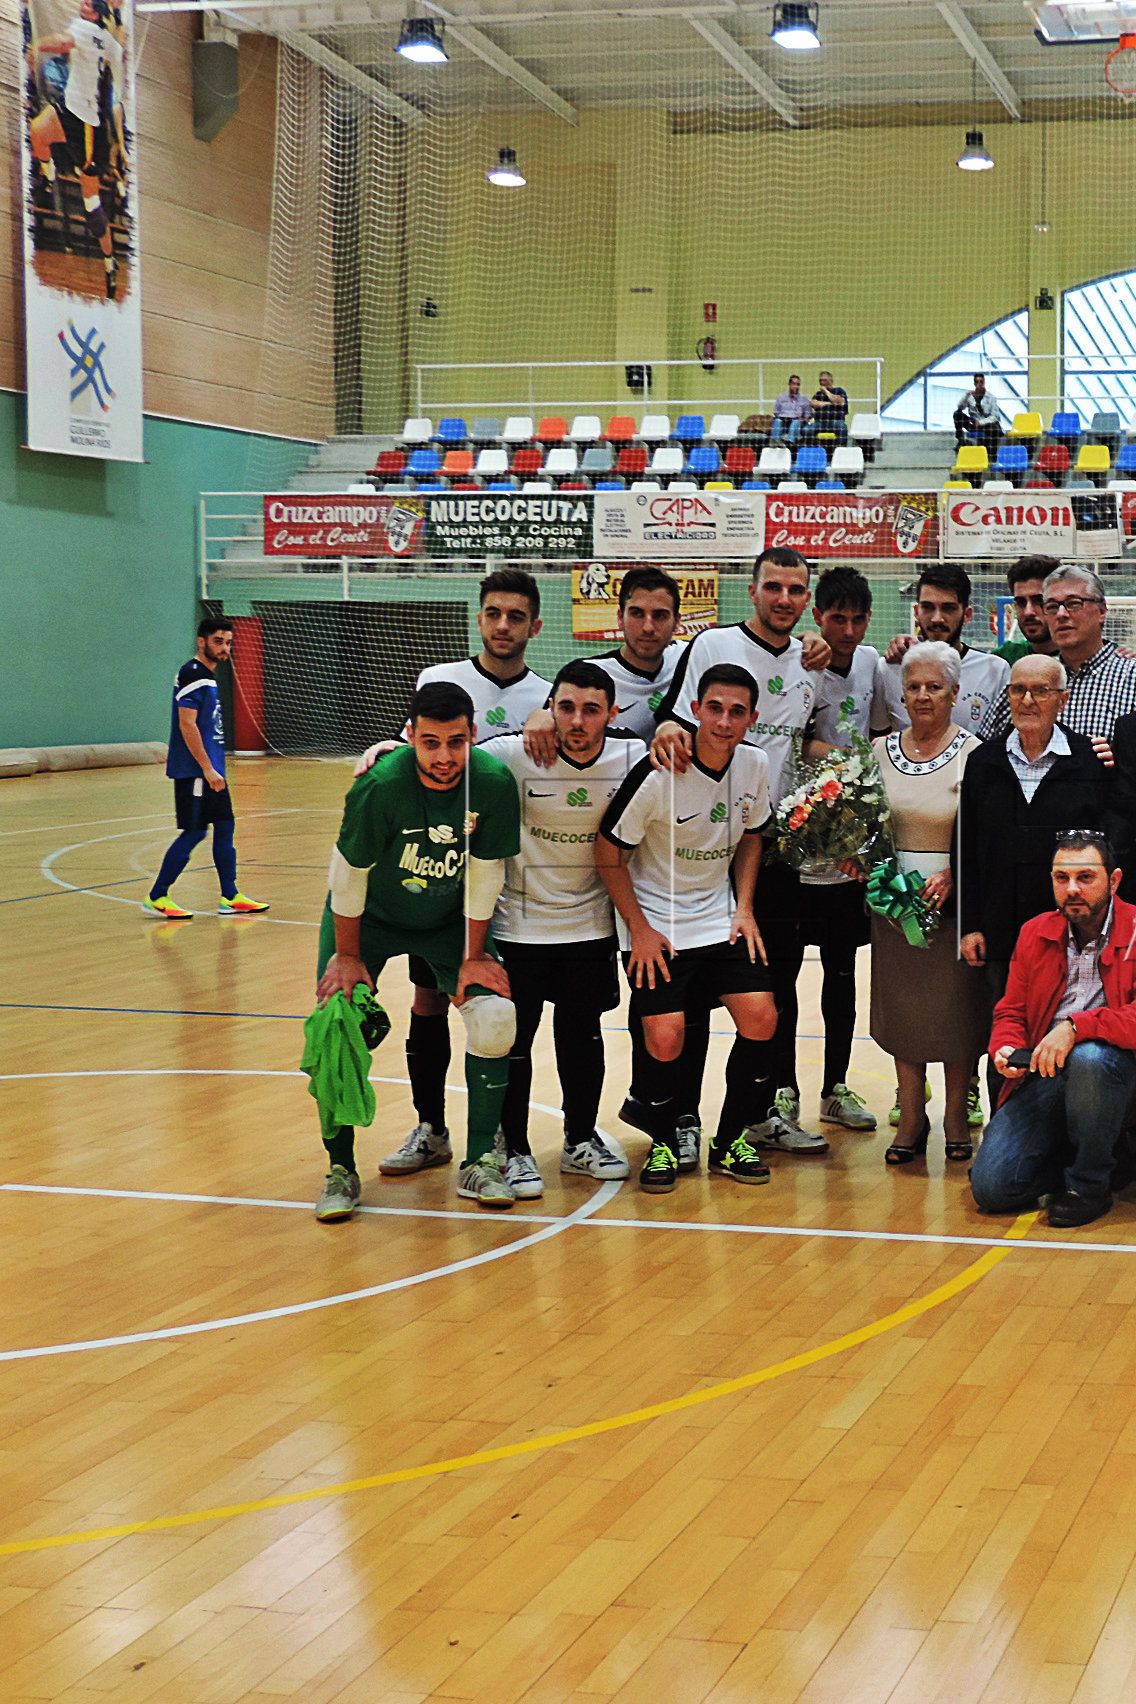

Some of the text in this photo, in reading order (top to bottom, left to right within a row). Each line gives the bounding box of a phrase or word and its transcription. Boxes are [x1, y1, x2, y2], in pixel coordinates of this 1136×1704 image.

[269, 502, 378, 527] Cruzcampo
[430, 499, 588, 522] MUECOCEUTA
[769, 501, 884, 528] Cruzcampo
[950, 502, 1071, 527] Canon
[273, 530, 304, 548] Con
[309, 530, 324, 544] el
[436, 525, 583, 535] Muebles y Cocina
[772, 530, 806, 548] Con
[810, 531, 824, 546] el
[485, 537, 512, 547] 856
[515, 537, 544, 547] 206
[548, 537, 576, 547] 292
